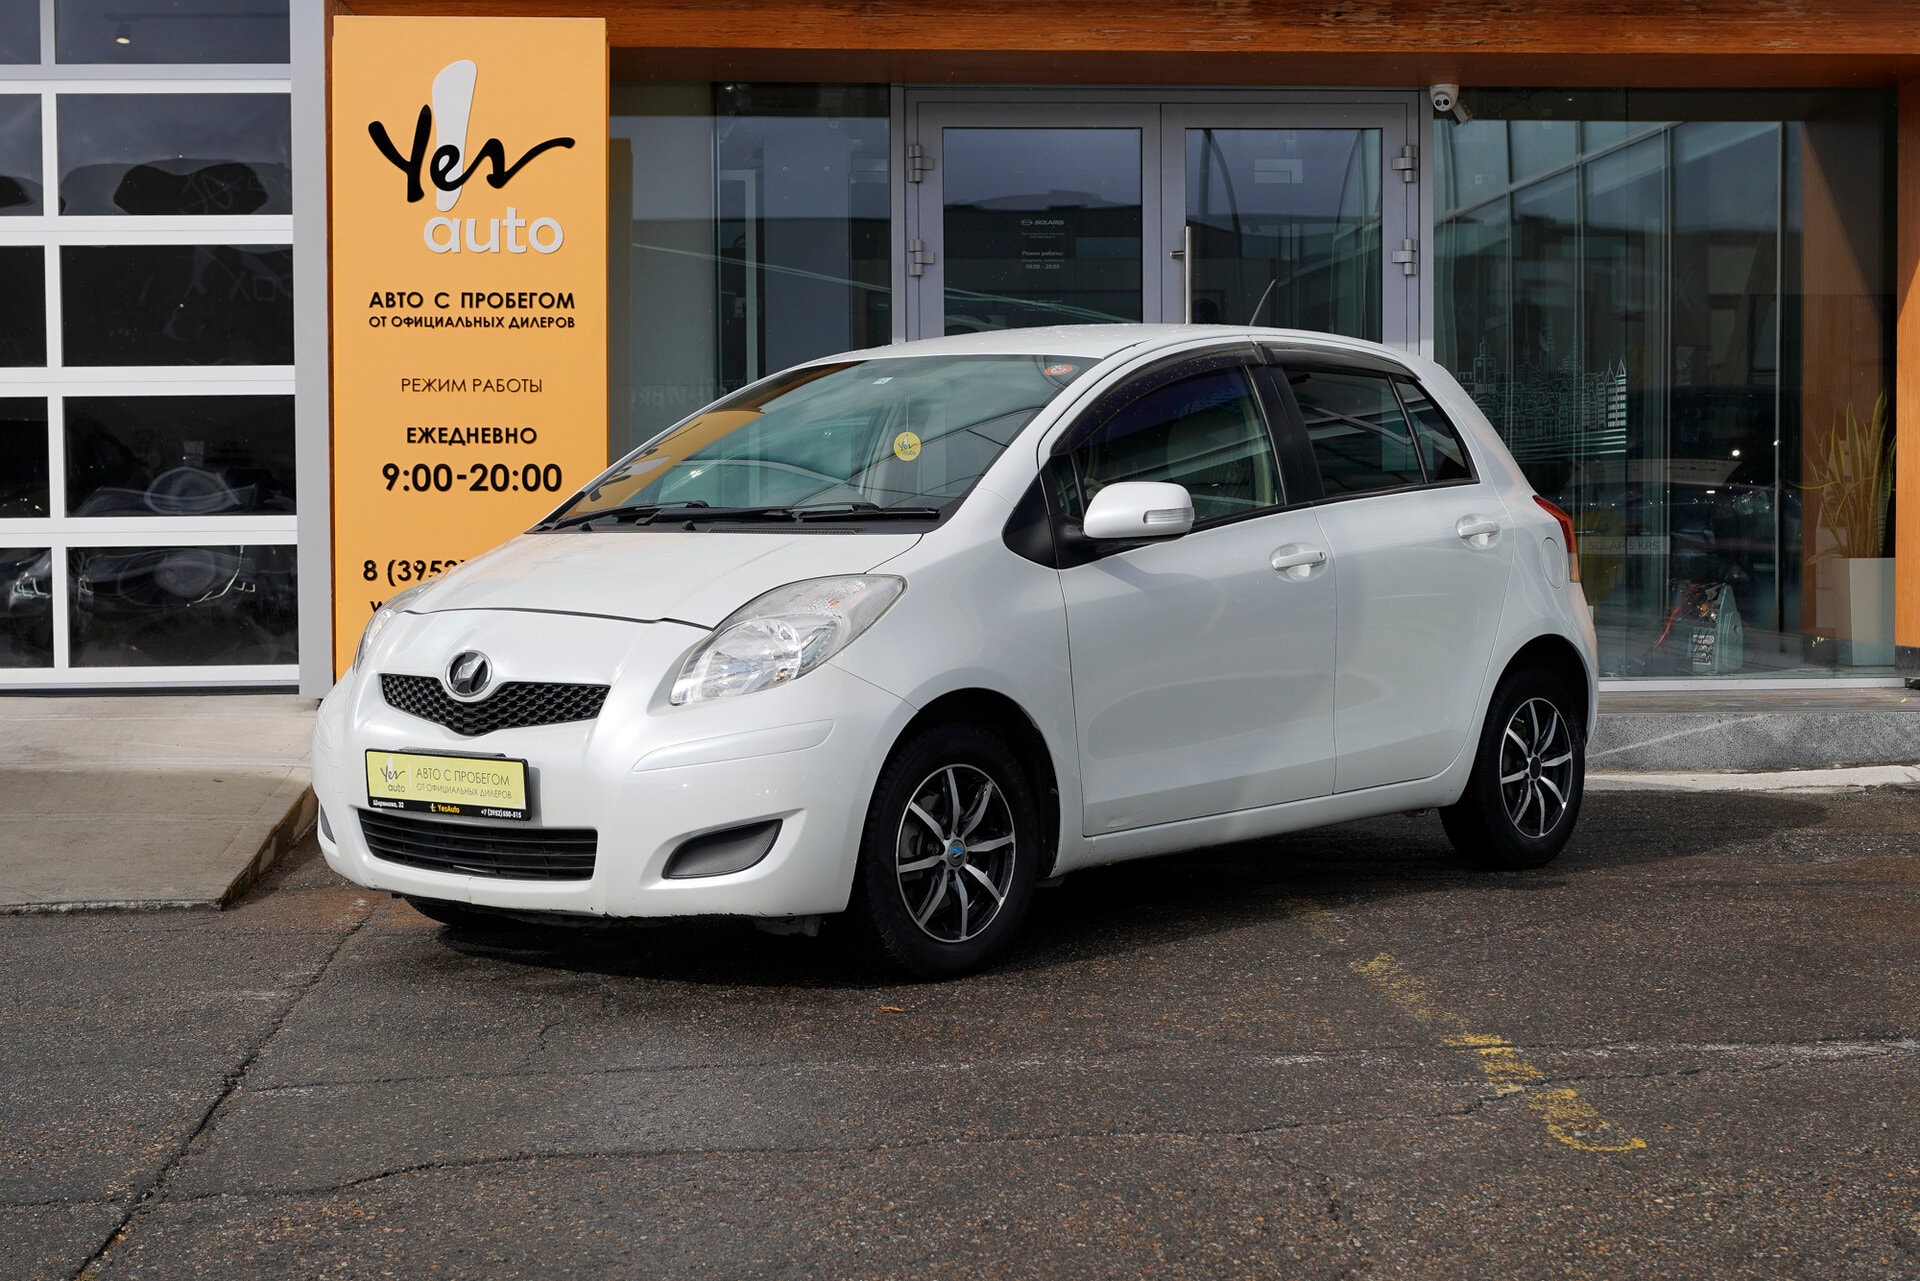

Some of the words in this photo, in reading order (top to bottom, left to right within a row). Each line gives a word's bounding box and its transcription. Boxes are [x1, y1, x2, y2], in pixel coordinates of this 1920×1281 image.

[424, 207, 564, 254] auto
[369, 291, 424, 309] АВТО
[434, 291, 450, 309] С
[460, 291, 575, 309] ПРОБЕГОМ
[369, 316, 387, 328] ОТ
[391, 316, 504, 329] ОФИЦИАЛЬНЫХ
[508, 316, 575, 329] ДИЛЕРОВ
[401, 378, 467, 392] РЕЖИМ
[472, 378, 543, 392] РАБОТЫ
[406, 427, 537, 446] ЕЖЕДНЕВНО
[382, 463, 562, 492] 9:00-20:00
[1587, 541, 1635, 551] SOLARS
[363, 560, 378, 581] 8
[387, 560, 466, 586] (395
[416, 767, 441, 781] АВТО
[443, 769, 452, 782] С
[454, 770, 510, 786] ПРОБЕГОМ
[388, 783, 405, 793] auto
[416, 782, 426, 791] ОТ
[426, 783, 478, 796] ОФИЦИАЛЬНЫХ
[480, 788, 513, 799] ДИЛЕРОВ
[437, 804, 460, 814] YesAuto
